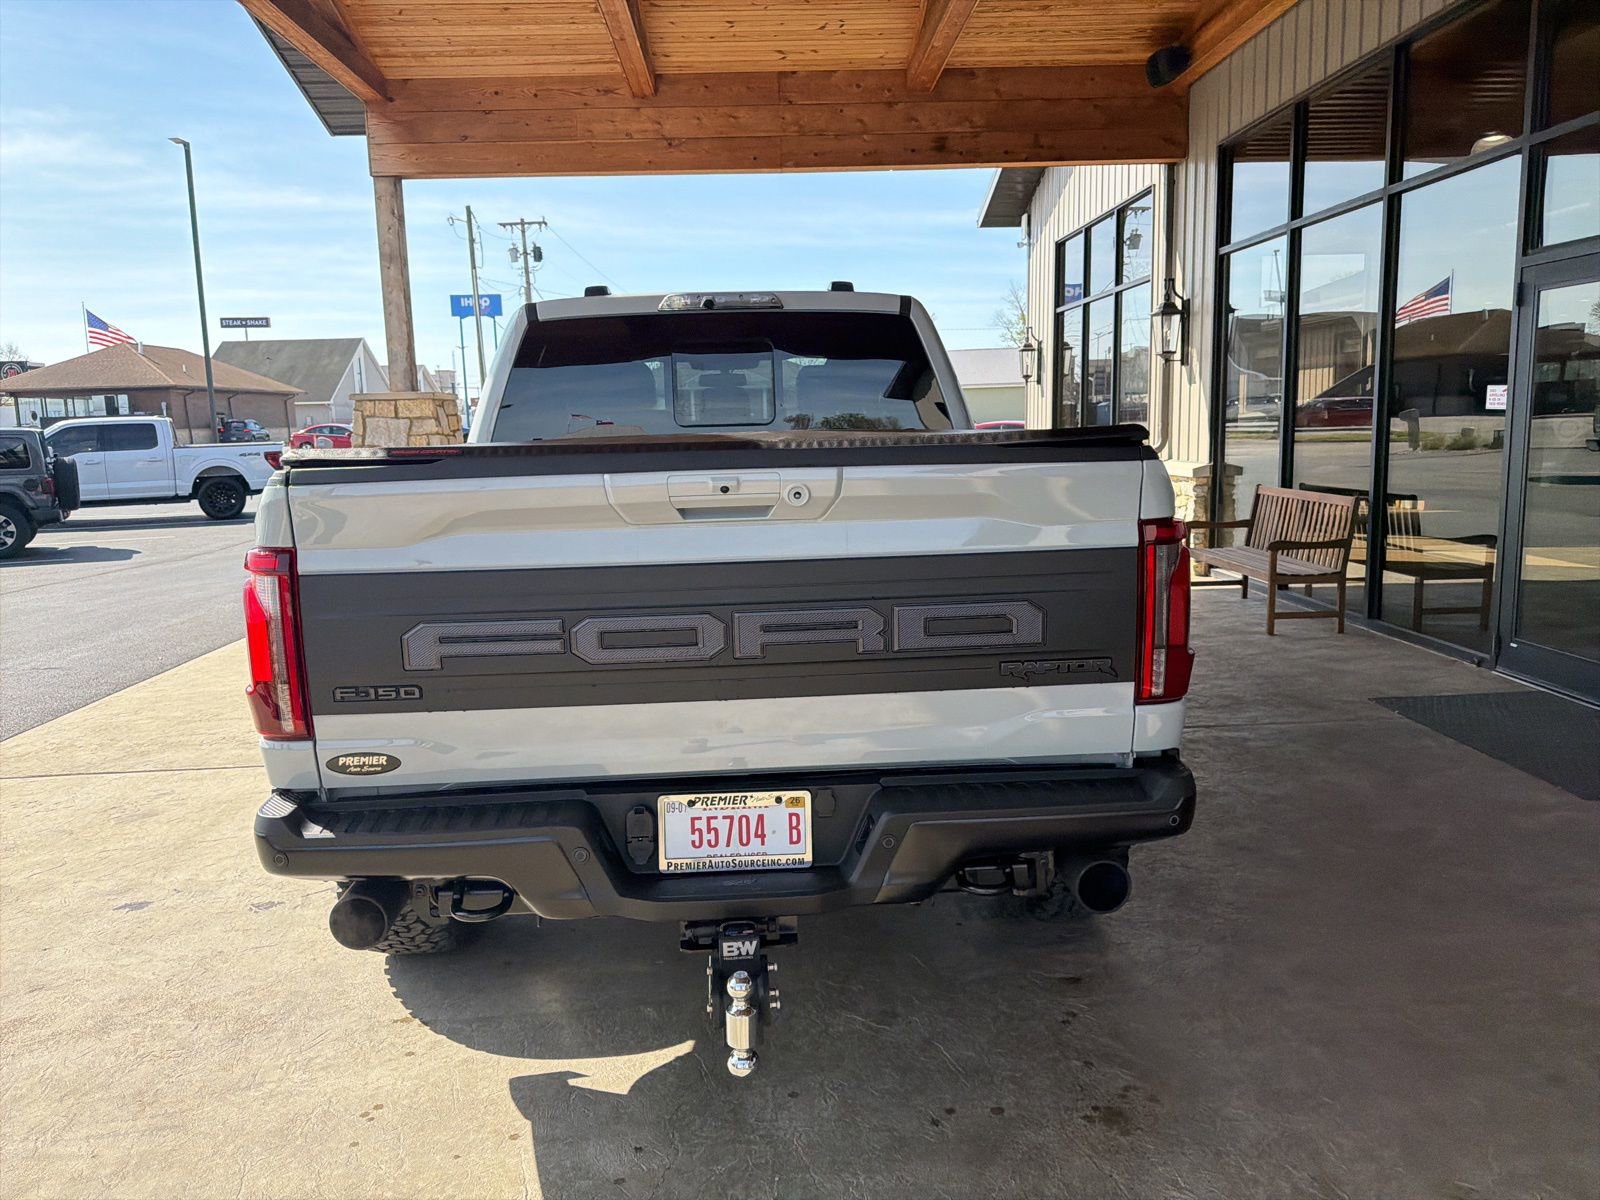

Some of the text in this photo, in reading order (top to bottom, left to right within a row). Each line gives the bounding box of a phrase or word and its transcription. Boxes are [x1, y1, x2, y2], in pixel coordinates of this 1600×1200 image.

[401, 598, 1047, 672] FORD
[999, 657, 1118, 682] RAPTOR
[333, 685, 422, 702] F-150
[338, 756, 387, 766] PREMIER
[693, 795, 748, 807] PREMIER
[690, 812, 801, 849] 55704 B
[666, 858, 805, 871] PREMIERAUTOSOURCEINC.COM
